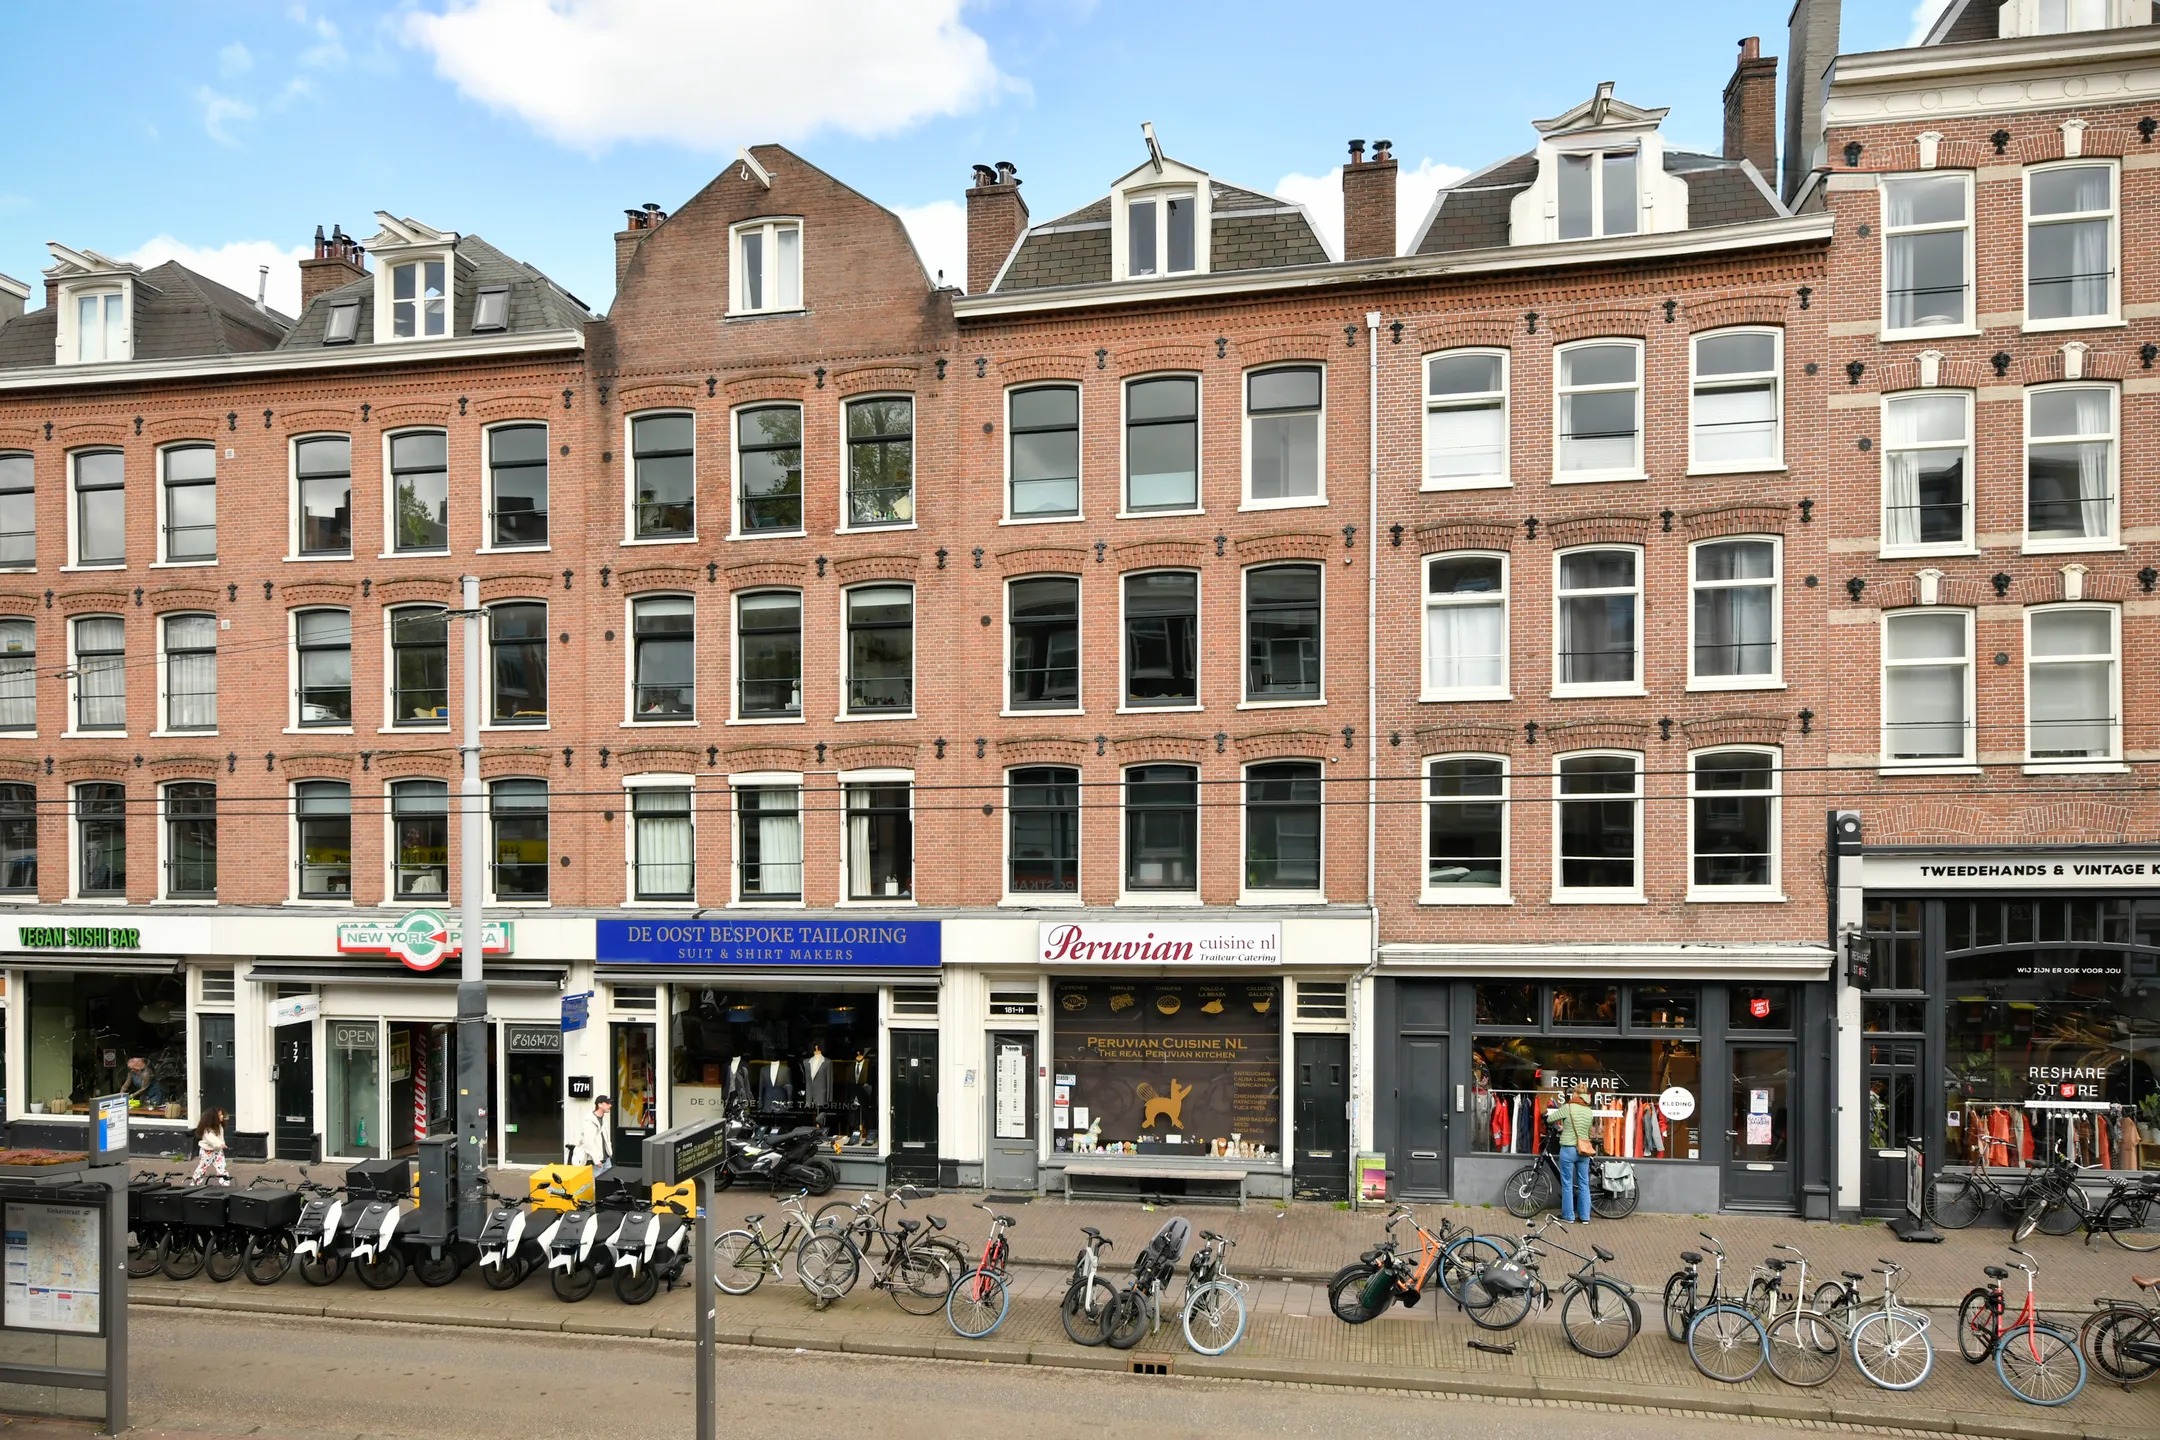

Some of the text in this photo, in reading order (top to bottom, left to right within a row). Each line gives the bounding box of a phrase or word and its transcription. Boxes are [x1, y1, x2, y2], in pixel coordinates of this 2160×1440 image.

[1920, 865, 2047, 877] TWEEDEHANDS
[2053, 865, 2064, 876] &
[2073, 864, 2145, 876] VINTAGE
[18, 927, 140, 948] VEGAN SUSHI BAR
[346, 932, 383, 943] NEW
[387, 931, 438, 945] YORK
[627, 926, 907, 944] DE OOST BESPOKE TAILORING
[1044, 924, 1276, 961] Peruvian cuisine nl
[678, 948, 853, 960] SUIT & SHIRT MAKERS
[2104, 967, 2121, 975] JOU
[1004, 1006, 1024, 1014] 181-H
[338, 1029, 375, 1043] OPEN
[520, 1034, 559, 1047] 6161473
[1225, 1038, 1248, 1050] NL
[2029, 1066, 2106, 1080] RESHARE
[573, 1082, 590, 1093] 177H
[1551, 1076, 1619, 1089] RESHARE
[690, 1097, 705, 1106] DE
